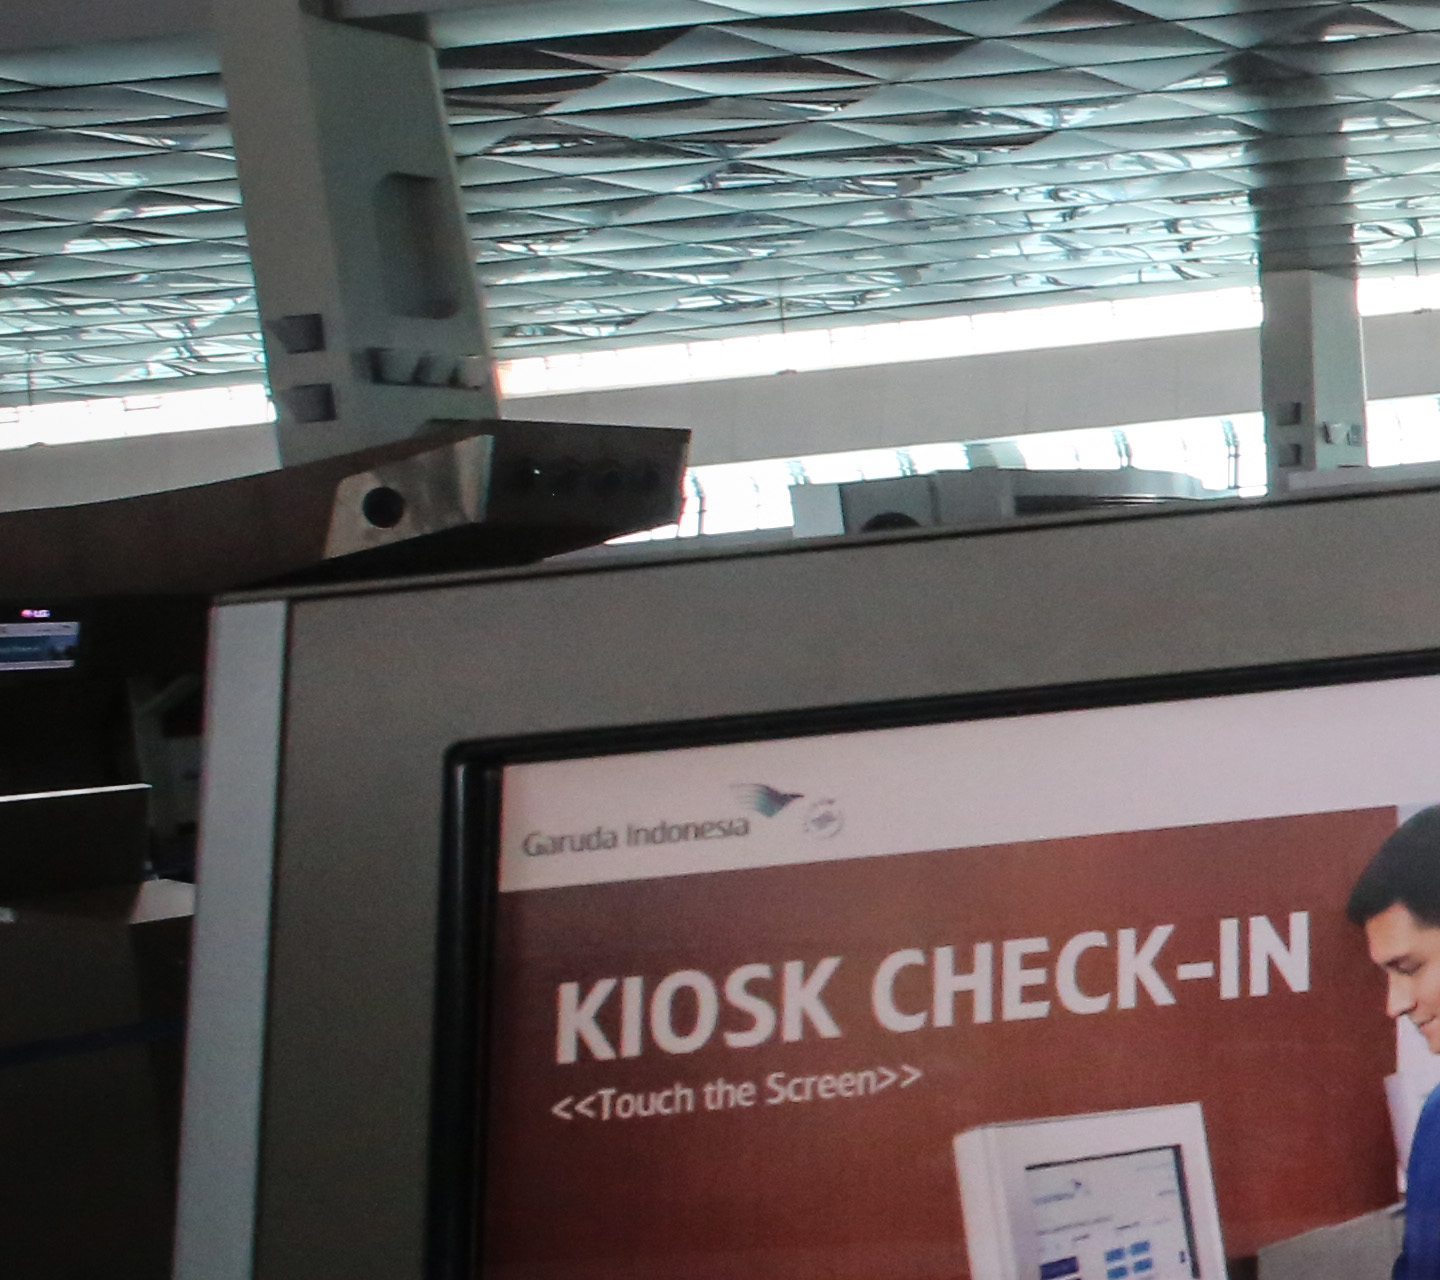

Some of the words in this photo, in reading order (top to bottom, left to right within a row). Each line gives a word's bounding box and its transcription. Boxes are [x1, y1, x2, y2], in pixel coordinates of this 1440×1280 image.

[522, 823, 619, 858] Garuda
[626, 814, 751, 847] Indonesia
[556, 956, 843, 1065] KIOSK
[872, 911, 1310, 1035] CHECK-IN
[704, 1076, 757, 1110] the
